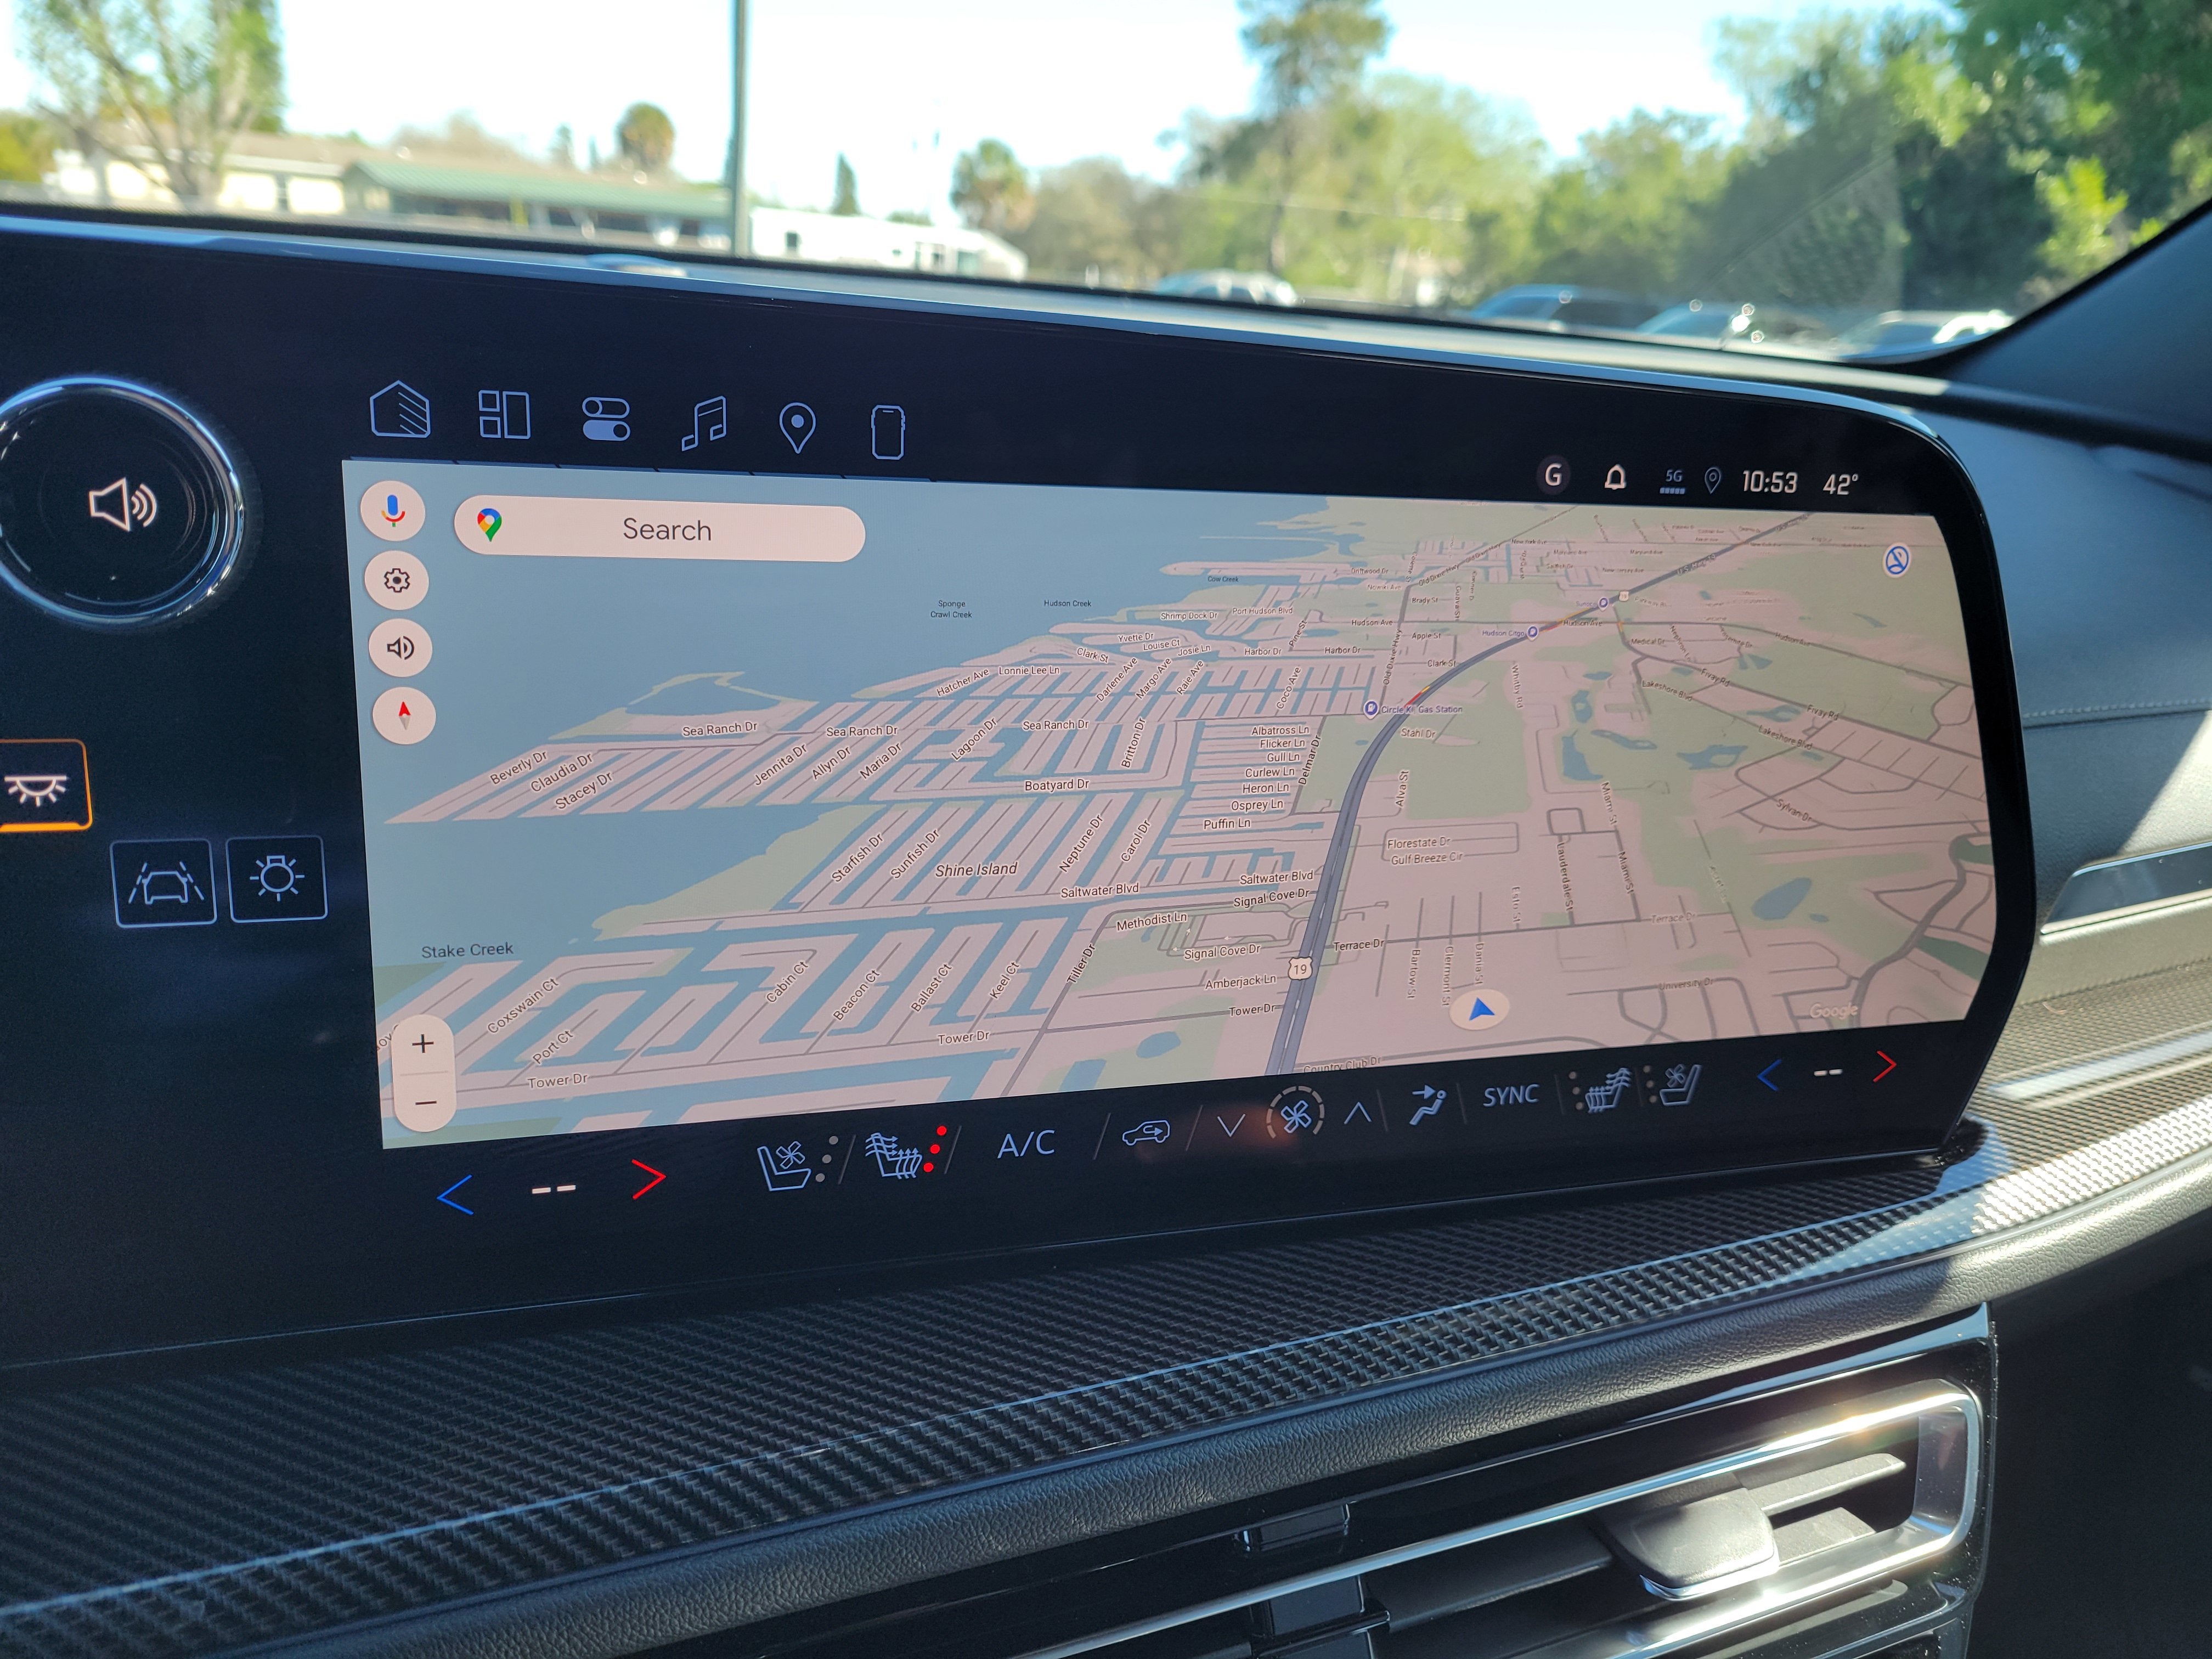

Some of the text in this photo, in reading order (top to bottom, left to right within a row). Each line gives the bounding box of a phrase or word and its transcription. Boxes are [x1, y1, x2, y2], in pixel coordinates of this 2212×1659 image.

[1545, 464, 1561, 486] G
[1666, 470, 1682, 482] 5G
[1743, 470, 1798, 494] 10:53
[1823, 474, 1858, 495] 42°
[623, 517, 711, 540] Search
[1143, 641, 1167, 651] Louise
[1289, 619, 1307, 647] Pine St
[1077, 648, 1108, 663] Clark St
[1178, 647, 1199, 656] Josie
[1383, 629, 1402, 685] Old Dixie Hwy
[937, 668, 989, 697] Hatcher Ave
[999, 666, 1059, 675] Lonnie Lee Ln
[1096, 658, 1138, 701] Darlene Ave
[1136, 658, 1172, 699] Margo Ave
[1277, 667, 1301, 709] Coco Ave
[1512, 665, 1523, 708] Whitby Rd
[1642, 680, 1678, 696] Lakeshore
[683, 721, 757, 736] Sea Ranch Dr
[1023, 720, 1089, 730] Sea Ranch Dr
[1252, 727, 1296, 735] Albatross
[951, 718, 997, 761] Lagoon Dr
[1122, 718, 1146, 768] Britton Dr
[1260, 740, 1290, 748] Flicker
[490, 751, 548, 785] Beverly Dr
[755, 744, 807, 786] Jennita Dr
[812, 746, 851, 779] Allyn Dr
[860, 743, 902, 778] Maria Dr
[1267, 753, 1285, 761] Gull
[1299, 735, 1321, 785] Delmar Dr
[531, 753, 593, 792] Claudia Dr
[1025, 780, 1089, 792] Boatyard Dr
[1245, 769, 1280, 777] Curlew
[555, 771, 613, 810] Stacey Dr
[1243, 784, 1273, 793] Heron
[1396, 771, 1409, 806] Alva St
[1232, 800, 1283, 812] Osprey Ln
[1601, 782, 1617, 825] Miami St
[1802, 812, 1812, 821] Dr
[1204, 819, 1251, 829] Puffin Ln
[891, 829, 940, 878] Sunfish Dr
[1059, 814, 1103, 872] Neptune Dr
[1121, 820, 1151, 862] Carol Dr
[1388, 837, 1451, 849] Florestate Dr
[832, 833, 884, 882] Starfish Dr
[936, 862, 1018, 877] Shine Island
[1240, 871, 1313, 884] Saltwater Blvd
[1557, 843, 1573, 911] Lauderdale St
[1619, 851, 1634, 894] Miami St
[1234, 889, 1310, 907] Signal Cove Dr
[1116, 912, 1187, 931] Methodist Ln
[422, 942, 514, 958] Stake Creek
[1334, 939, 1385, 951] Terrace Dr
[1066, 944, 1095, 983] Tiller Dr
[1294, 964, 1307, 975] 19
[1407, 950, 1420, 999] Bartow St
[1442, 946, 1453, 1007] Clermont St
[1474, 943, 1484, 984] Dania St
[766, 961, 809, 1002] Cabin Ct
[912, 963, 952, 1012] Ballast Ct
[990, 961, 1019, 998] Keel Ct
[1205, 974, 1276, 990] Amberjack Ln
[488, 978, 559, 1034] Coxswain Ct
[833, 969, 880, 1020] Beacon Ct
[1229, 1003, 1276, 1017] Tower Dr
[1810, 1003, 1859, 1018] Google
[533, 1030, 574, 1064] Port Ct
[528, 1074, 588, 1088] Tower Dr
[1483, 1085, 1539, 1107] SYNC
[997, 1130, 1055, 1159] A/C
